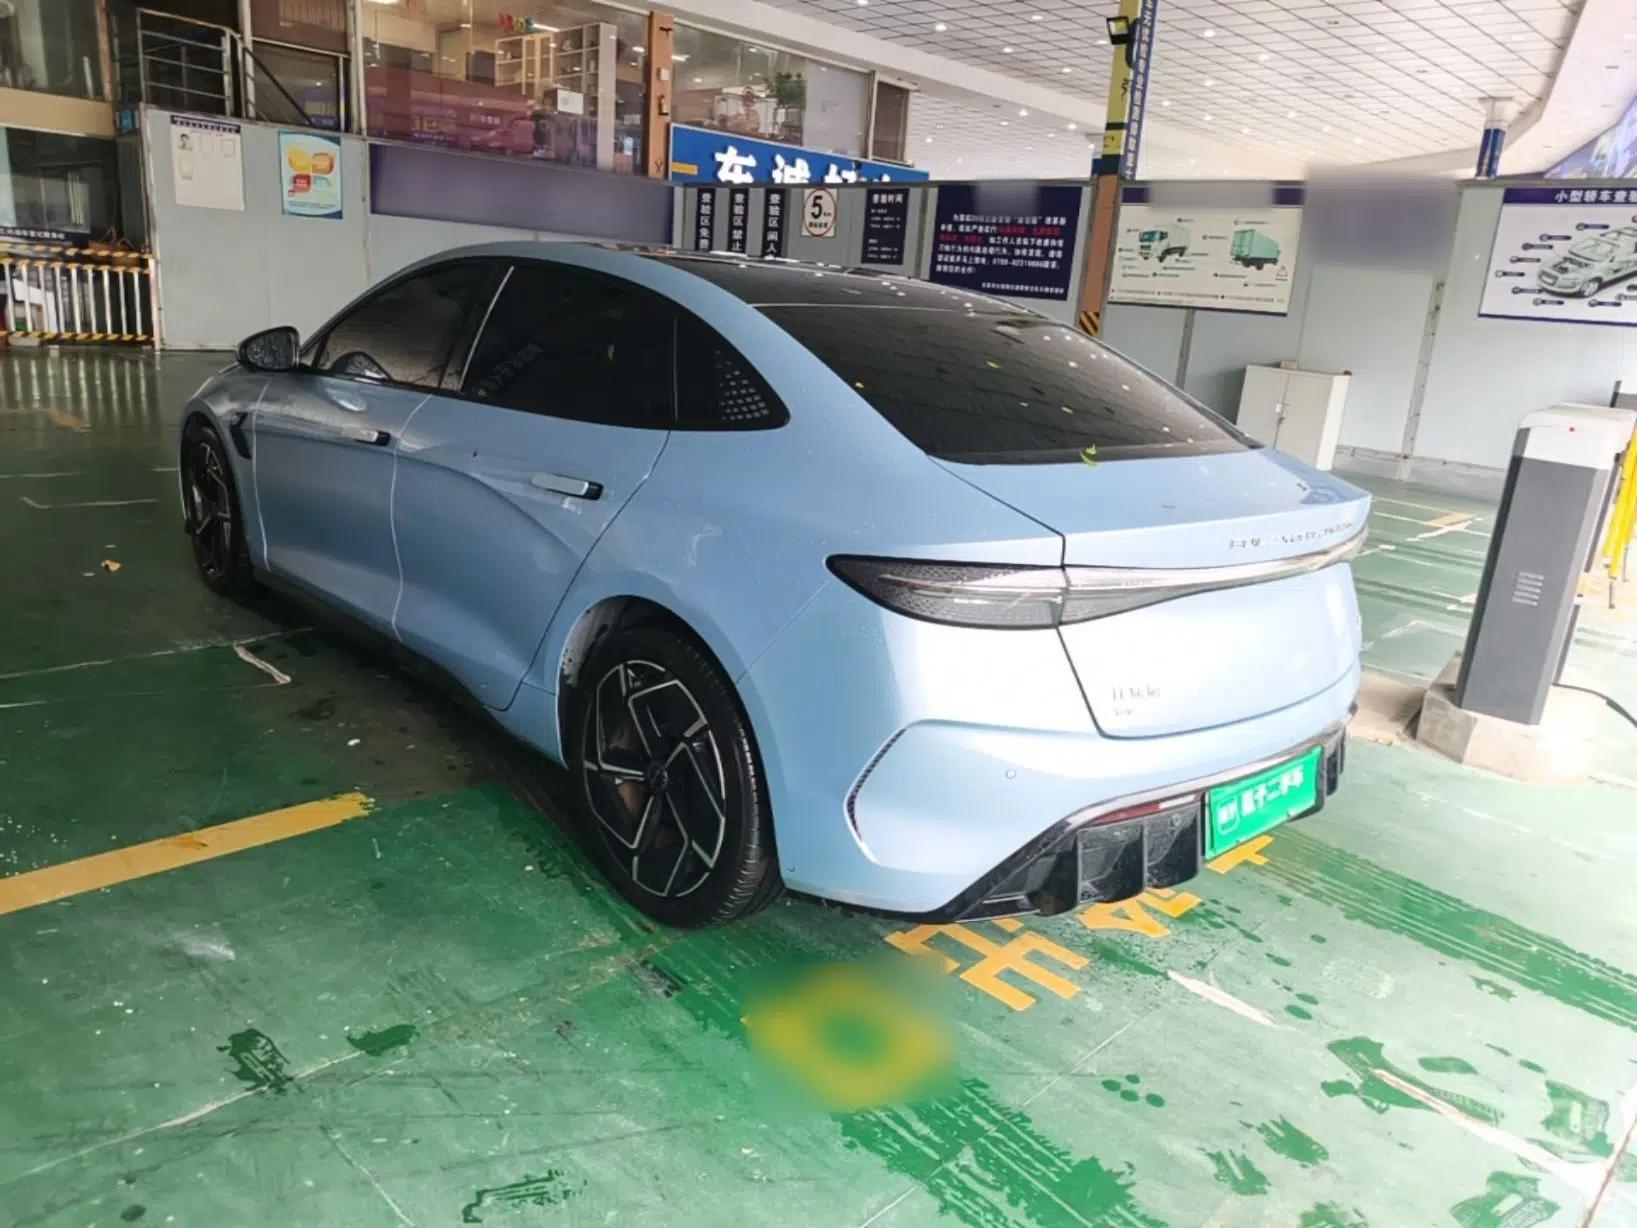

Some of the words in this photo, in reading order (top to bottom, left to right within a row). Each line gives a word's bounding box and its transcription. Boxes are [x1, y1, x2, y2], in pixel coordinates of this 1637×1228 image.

[766, 193, 781, 257] 查验区闲人
[811, 195, 822, 219] 5
